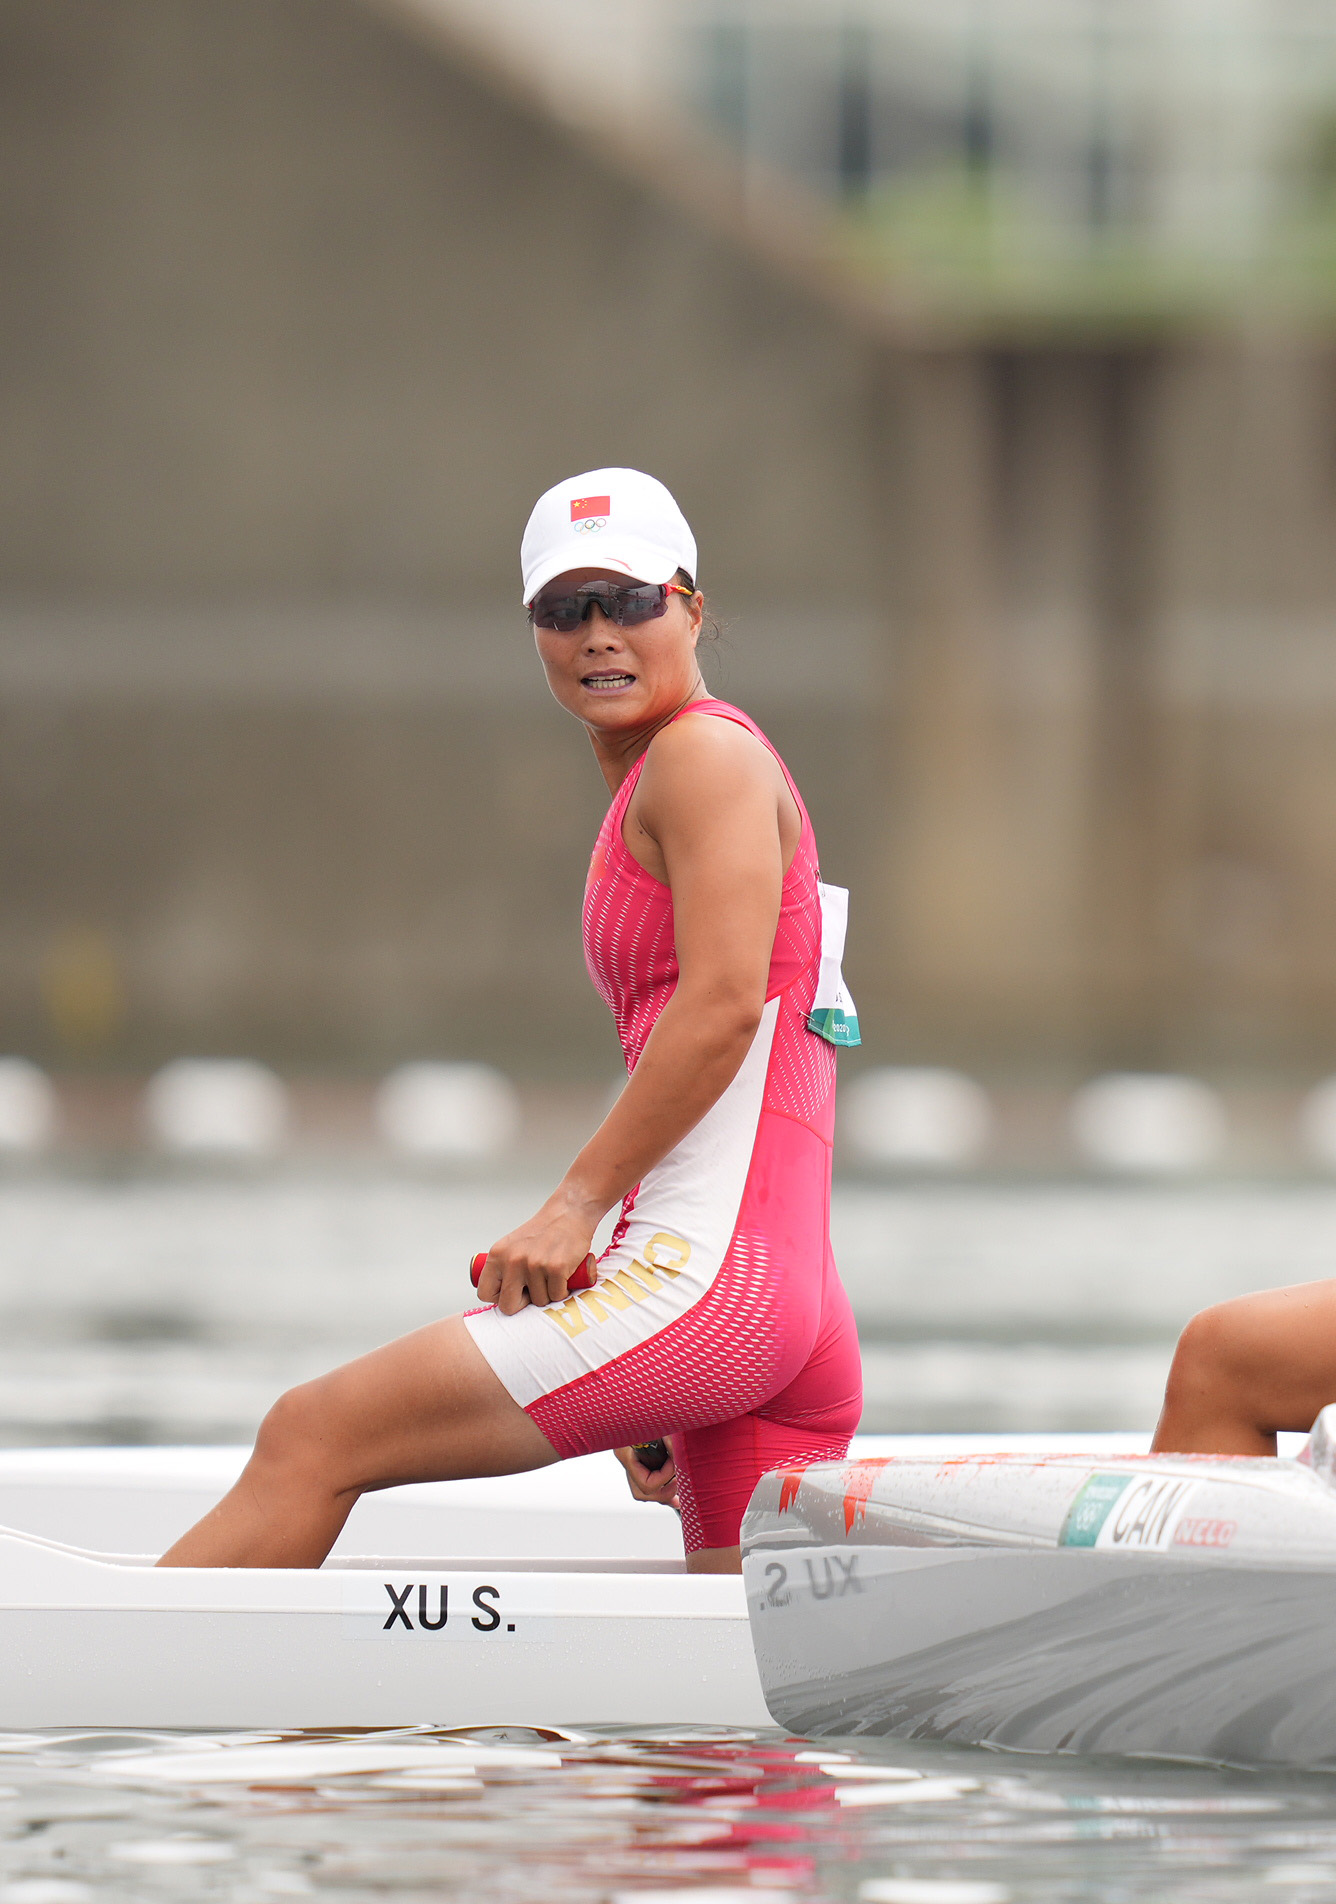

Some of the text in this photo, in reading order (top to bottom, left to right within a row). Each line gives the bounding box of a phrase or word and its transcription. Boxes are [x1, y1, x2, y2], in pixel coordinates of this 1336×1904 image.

[1112, 1479, 1195, 1546] CAN
[382, 1583, 516, 1632] XU S.
